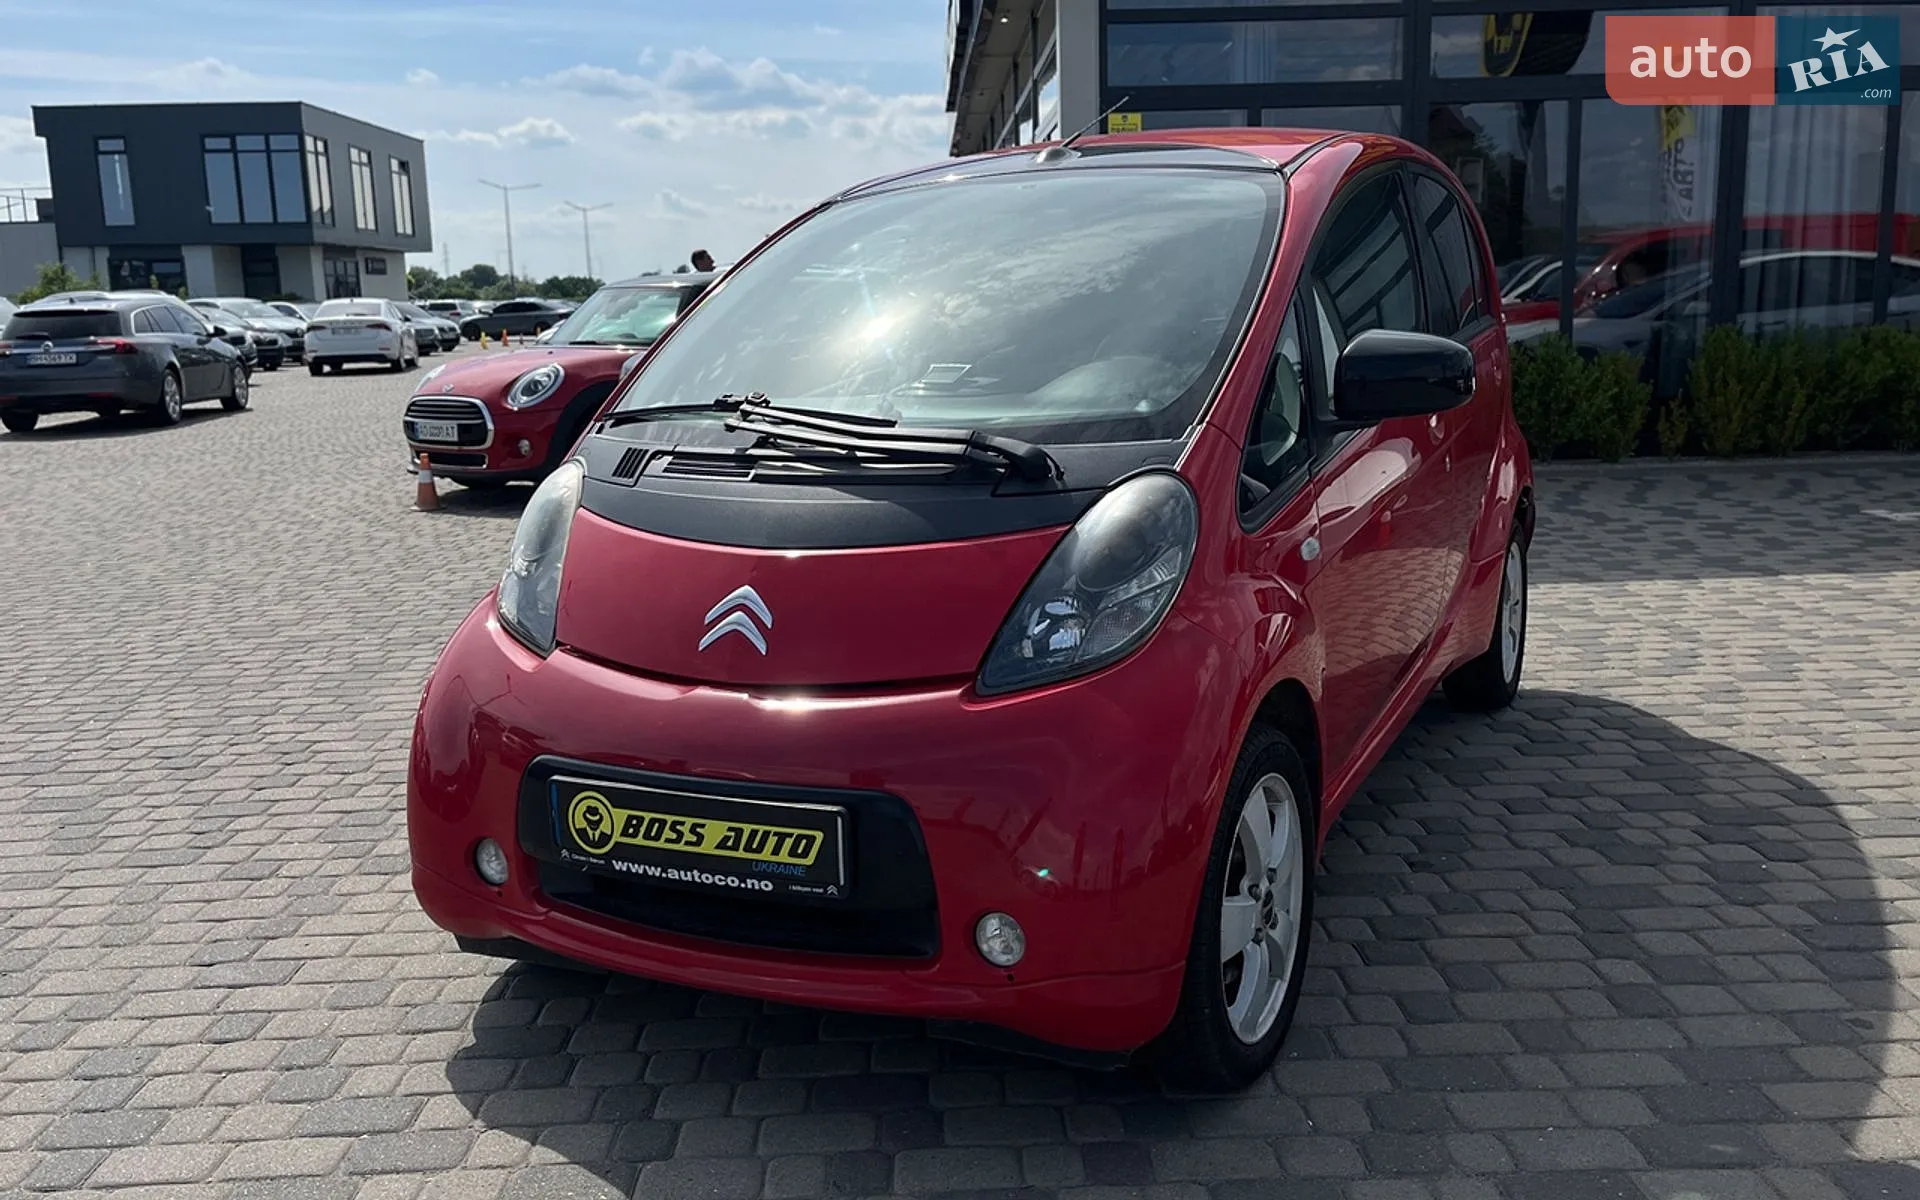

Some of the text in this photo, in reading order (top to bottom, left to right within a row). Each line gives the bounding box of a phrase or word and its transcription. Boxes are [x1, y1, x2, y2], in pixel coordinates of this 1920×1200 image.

[619, 814, 817, 859] BOSS AUTO
[611, 859, 774, 891] www.autoco.no
[752, 861, 807, 877] UKRAINE
